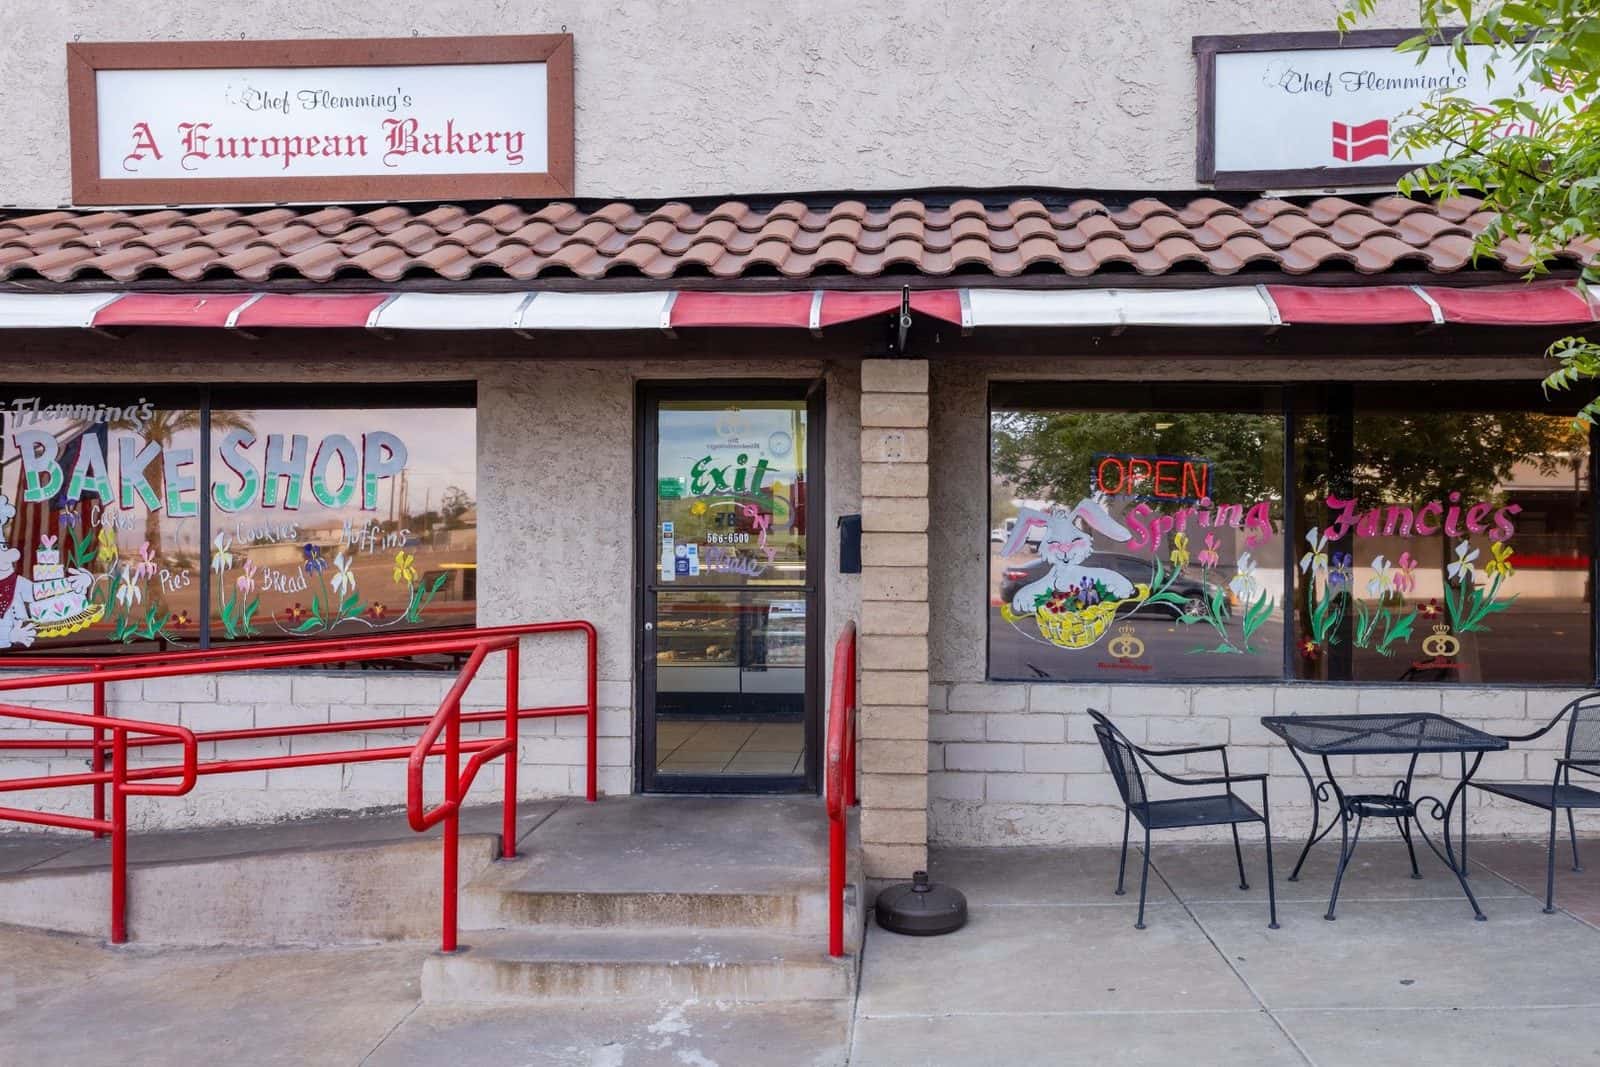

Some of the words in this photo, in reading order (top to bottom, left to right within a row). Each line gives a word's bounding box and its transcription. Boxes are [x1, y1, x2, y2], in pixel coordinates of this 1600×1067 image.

[245, 87, 291, 113] Chef
[297, 87, 412, 112] Flemming's
[1285, 71, 1333, 96] Chef
[122, 121, 163, 171] A
[178, 121, 368, 170] European
[382, 117, 526, 167] Bakery
[12, 397, 154, 432] Flemming's
[13, 430, 199, 518] BAKE
[212, 429, 408, 513] SHOP
[691, 453, 780, 497] Exit
[1097, 457, 1208, 499] OPEN
[706, 532, 749, 545] 566-6500
[1125, 497, 1274, 552] Spring
[1325, 492, 1522, 541] Fancies
[159, 569, 191, 594] Pies
